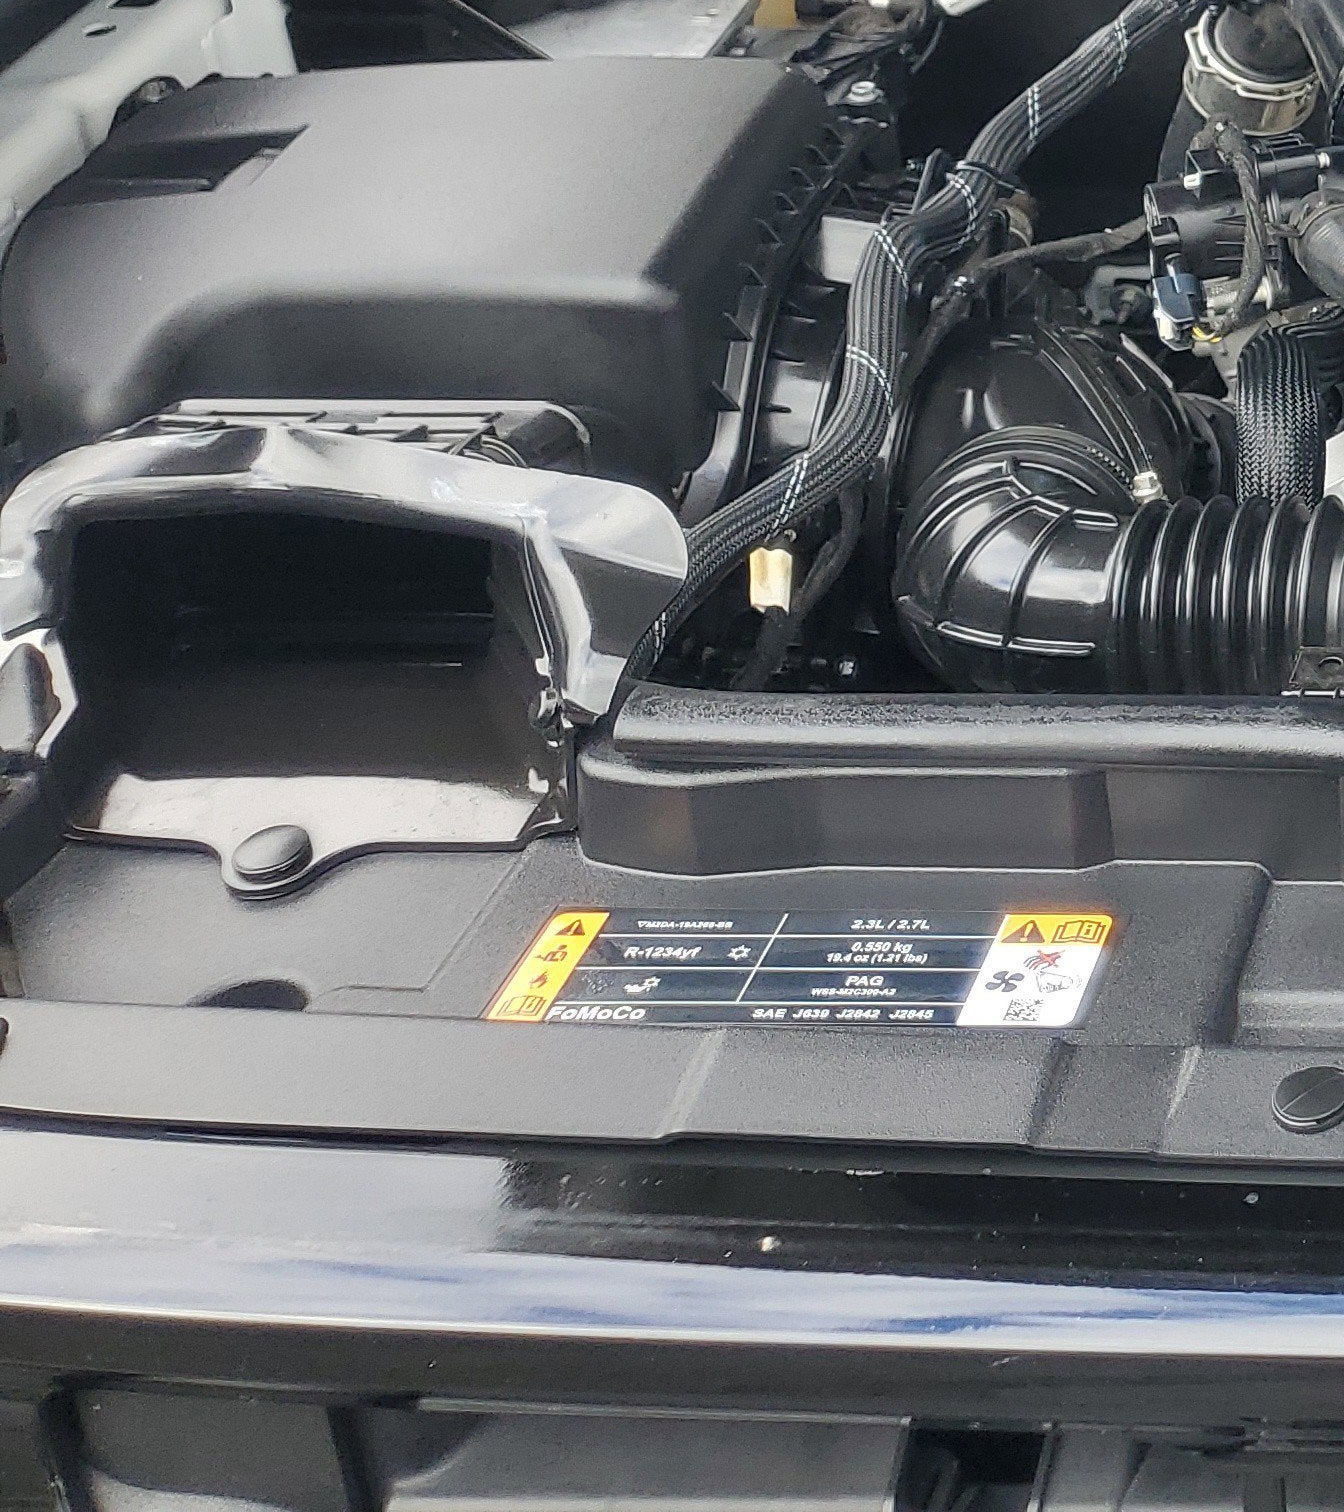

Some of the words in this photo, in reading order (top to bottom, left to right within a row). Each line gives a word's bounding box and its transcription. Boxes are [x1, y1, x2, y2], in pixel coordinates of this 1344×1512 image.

[851, 919, 884, 929] 2.3L
[897, 919, 930, 930] 2.7L
[851, 941, 891, 952] 0.550
[893, 943, 913, 953] kg
[624, 946, 702, 960] R-1234yf
[845, 975, 884, 986] PAG
[544, 1005, 647, 1021] FoMoCo
[752, 1008, 788, 1019] SAE
